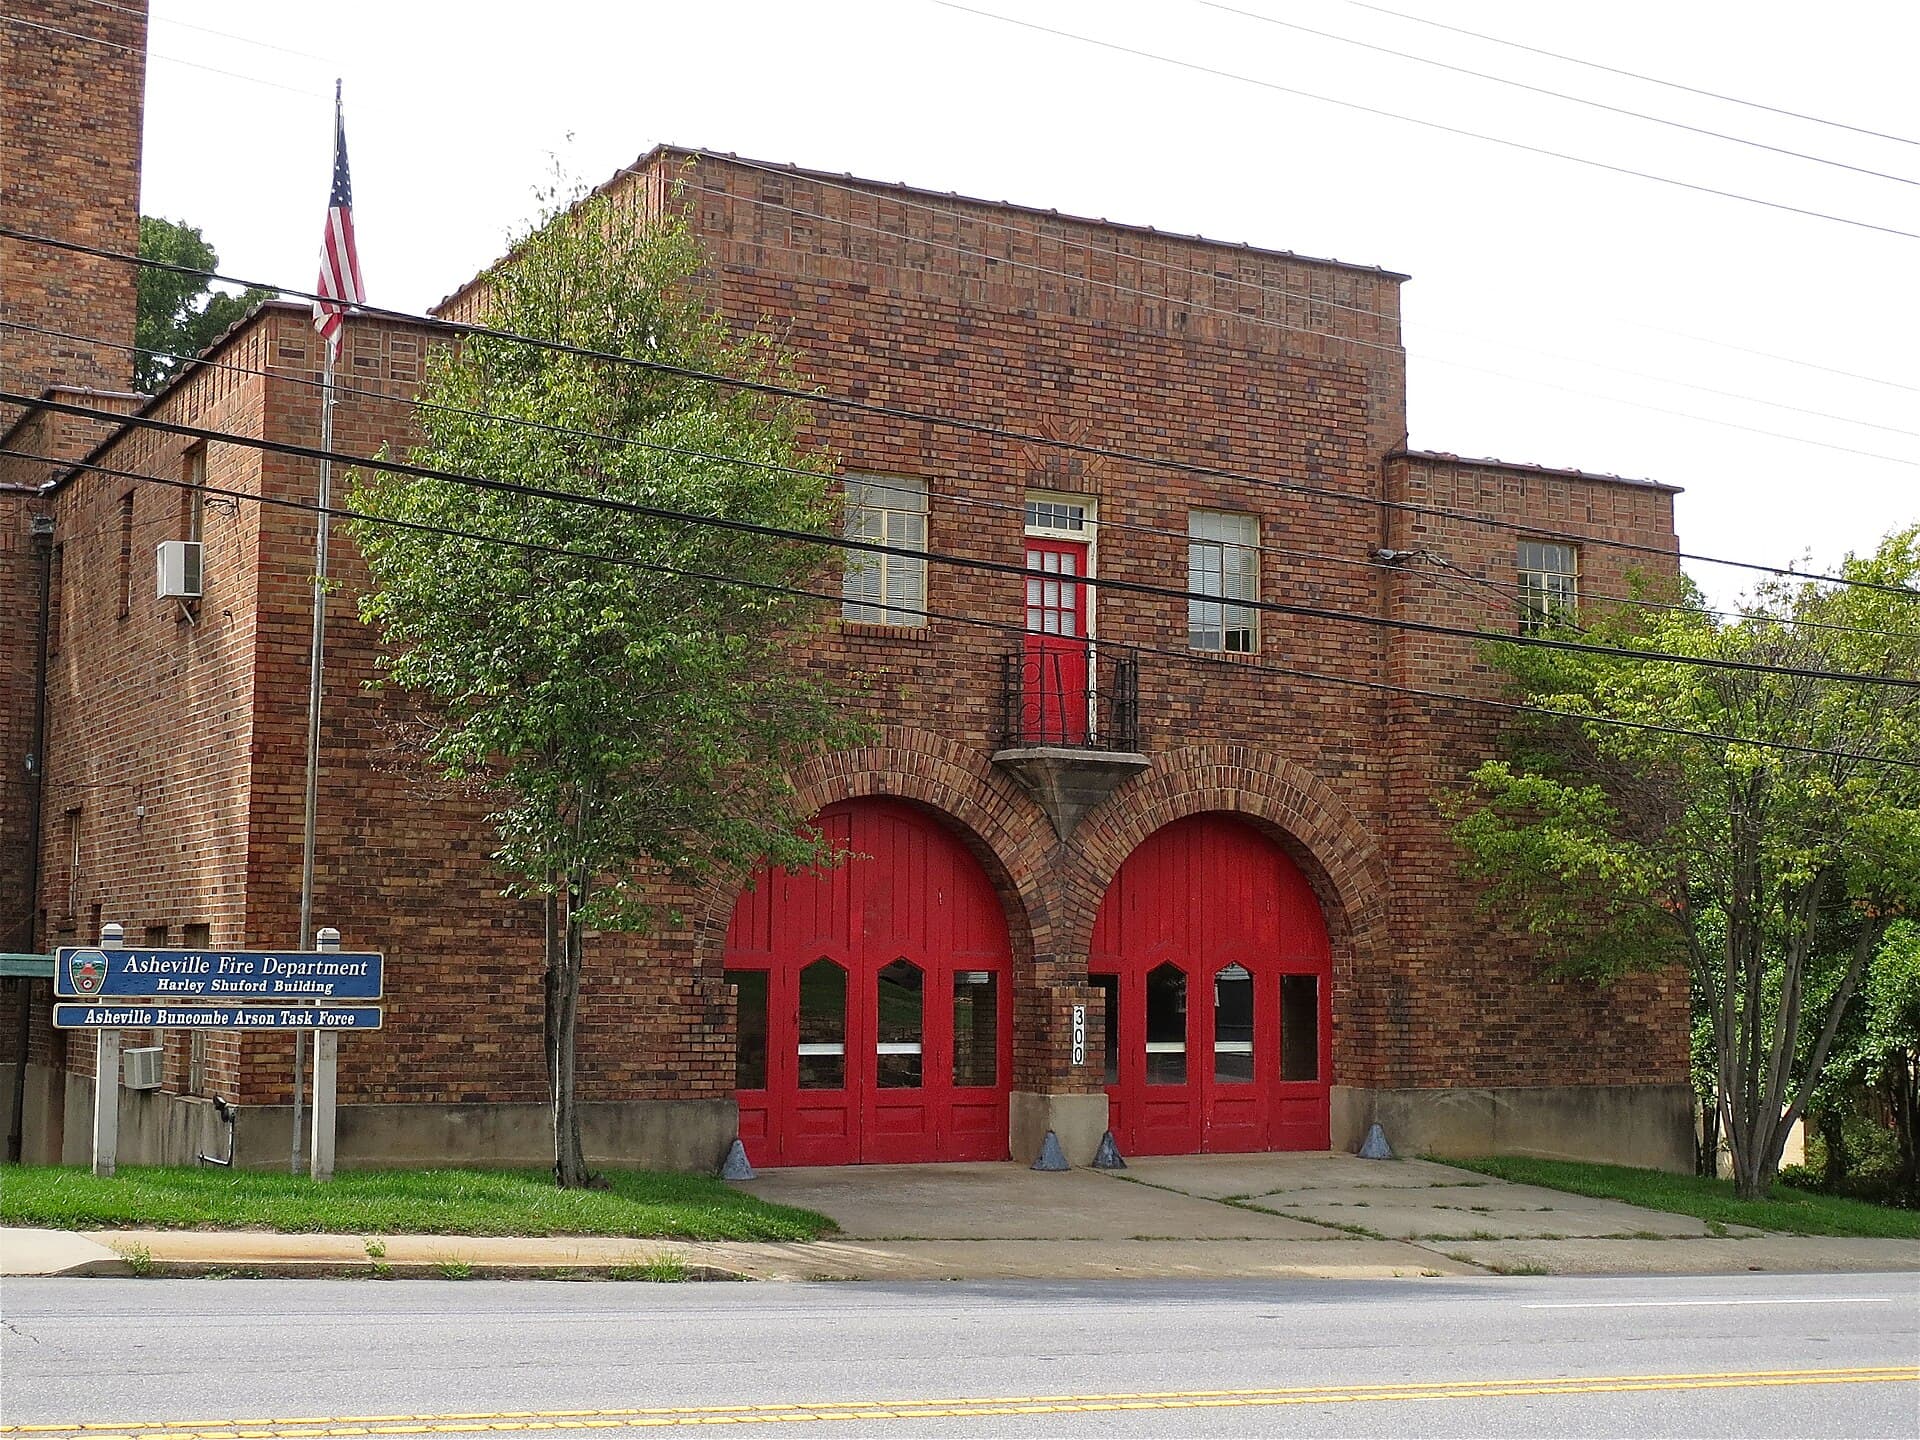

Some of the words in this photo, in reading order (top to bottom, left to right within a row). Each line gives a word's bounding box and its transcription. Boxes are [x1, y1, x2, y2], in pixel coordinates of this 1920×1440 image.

[123, 955, 210, 974] Asheville
[217, 956, 254, 975] Fire
[262, 957, 369, 978] Department
[156, 979, 205, 993] Harley
[211, 979, 267, 993] Shuford
[274, 980, 334, 995] Building
[84, 1008, 151, 1025] Asheville
[156, 1009, 229, 1025] Buncombe
[234, 1010, 275, 1025] Arson
[280, 1010, 313, 1025] Task
[317, 1011, 355, 1026] Force
[1074, 1009, 1083, 1063] 300
